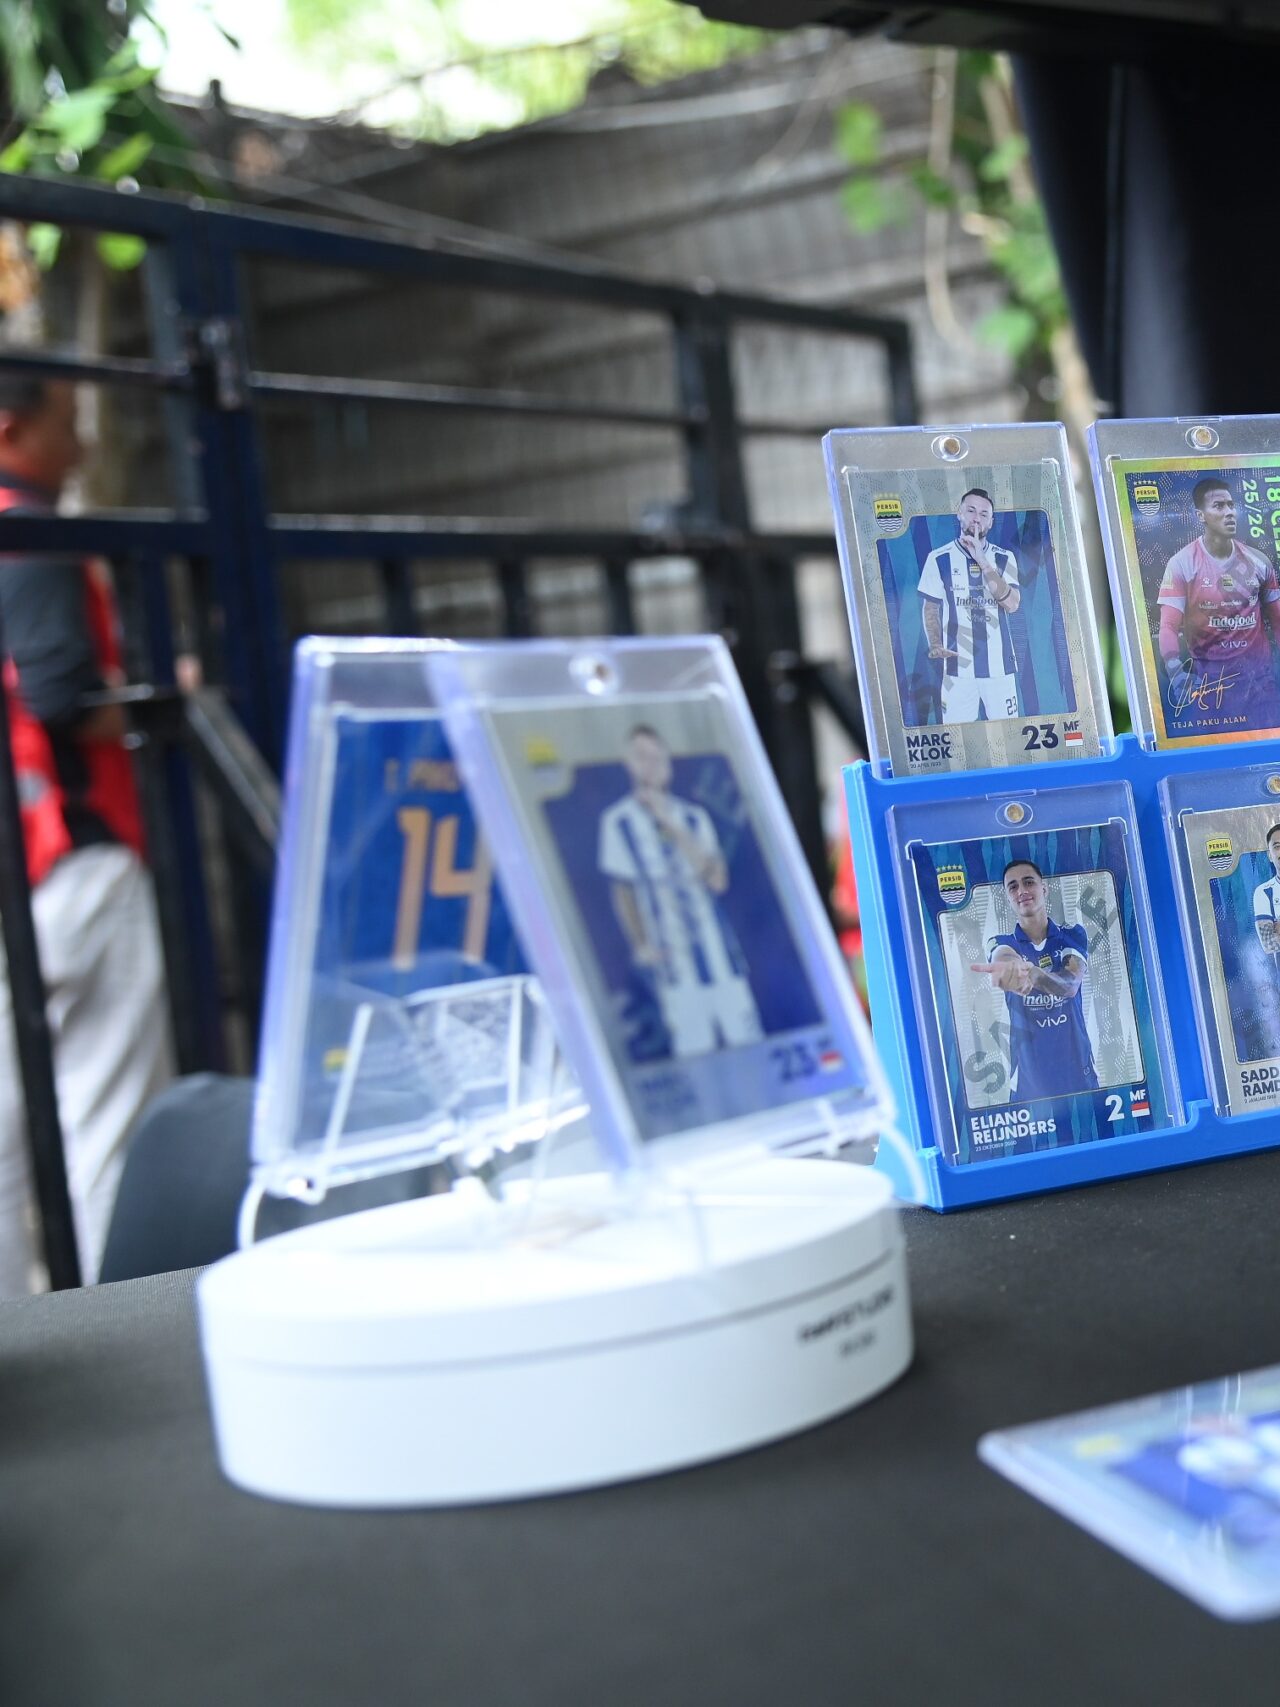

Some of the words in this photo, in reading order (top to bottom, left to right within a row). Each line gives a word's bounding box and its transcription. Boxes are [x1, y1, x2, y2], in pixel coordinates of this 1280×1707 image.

[876, 503, 899, 511] PERSIB
[1242, 479, 1266, 538] 25/26
[1208, 612, 1257, 630] Indofood
[1171, 720, 1194, 729] TEJA
[1196, 718, 1220, 727] PAKU
[1223, 715, 1247, 725] ALAM
[906, 732, 951, 748] MARC
[1022, 723, 1059, 751] 23
[1063, 720, 1080, 732] MF
[909, 746, 953, 762] KLOK
[1208, 842, 1229, 850] PERSIB
[939, 874, 962, 884] PERSIB
[393, 806, 490, 971] 14
[1036, 1014, 1068, 1028] vivo
[1105, 1094, 1125, 1122] 2
[1129, 1089, 1147, 1102] MF
[970, 1109, 1030, 1131] ELIANO
[972, 1119, 1057, 1145] REIJNDERS
